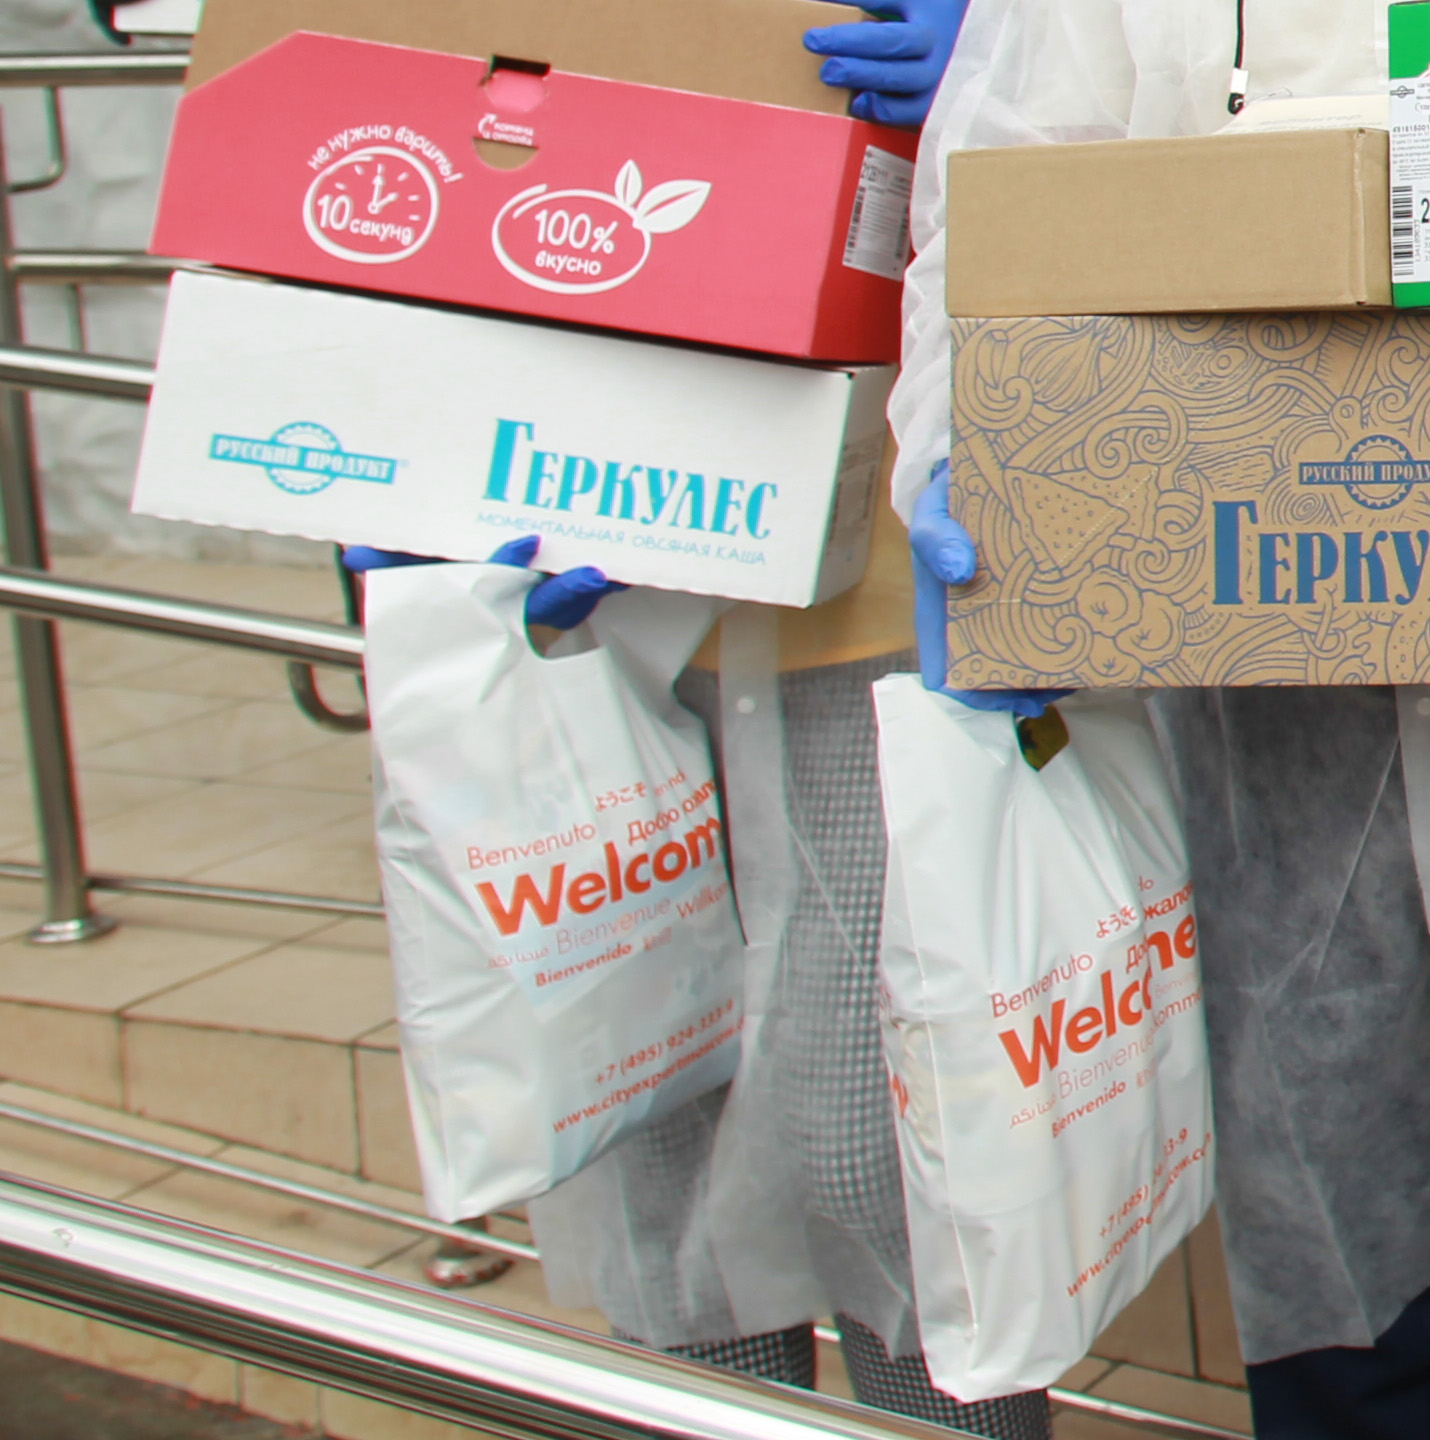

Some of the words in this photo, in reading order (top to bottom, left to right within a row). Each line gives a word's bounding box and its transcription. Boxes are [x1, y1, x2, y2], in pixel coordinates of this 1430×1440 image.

[307, 145, 331, 172] не
[327, 124, 392, 152] нужно
[394, 125, 464, 184] варить!
[317, 194, 352, 231] 10
[349, 216, 414, 246] секунд
[534, 209, 618, 255] 100%
[534, 250, 602, 276] вкусно
[216, 436, 300, 467] РУССКИЙ
[304, 449, 394, 481] ПРОДУКТ
[1301, 462, 1375, 483] РУССКИЙ
[475, 509, 626, 545] МОМЕНТАЛЬНАЯ
[631, 531, 711, 559] ОВСЯНАЯ
[714, 542, 767, 565] КАША
[466, 821, 597, 870] Benvenuto
[555, 897, 673, 955] Bienvenue
[534, 942, 634, 987] Bienvenido
[990, 953, 1094, 1019] Benvenuto
[595, 1064, 616, 1084] +7
[1051, 1080, 1127, 1140] Bienvenido
